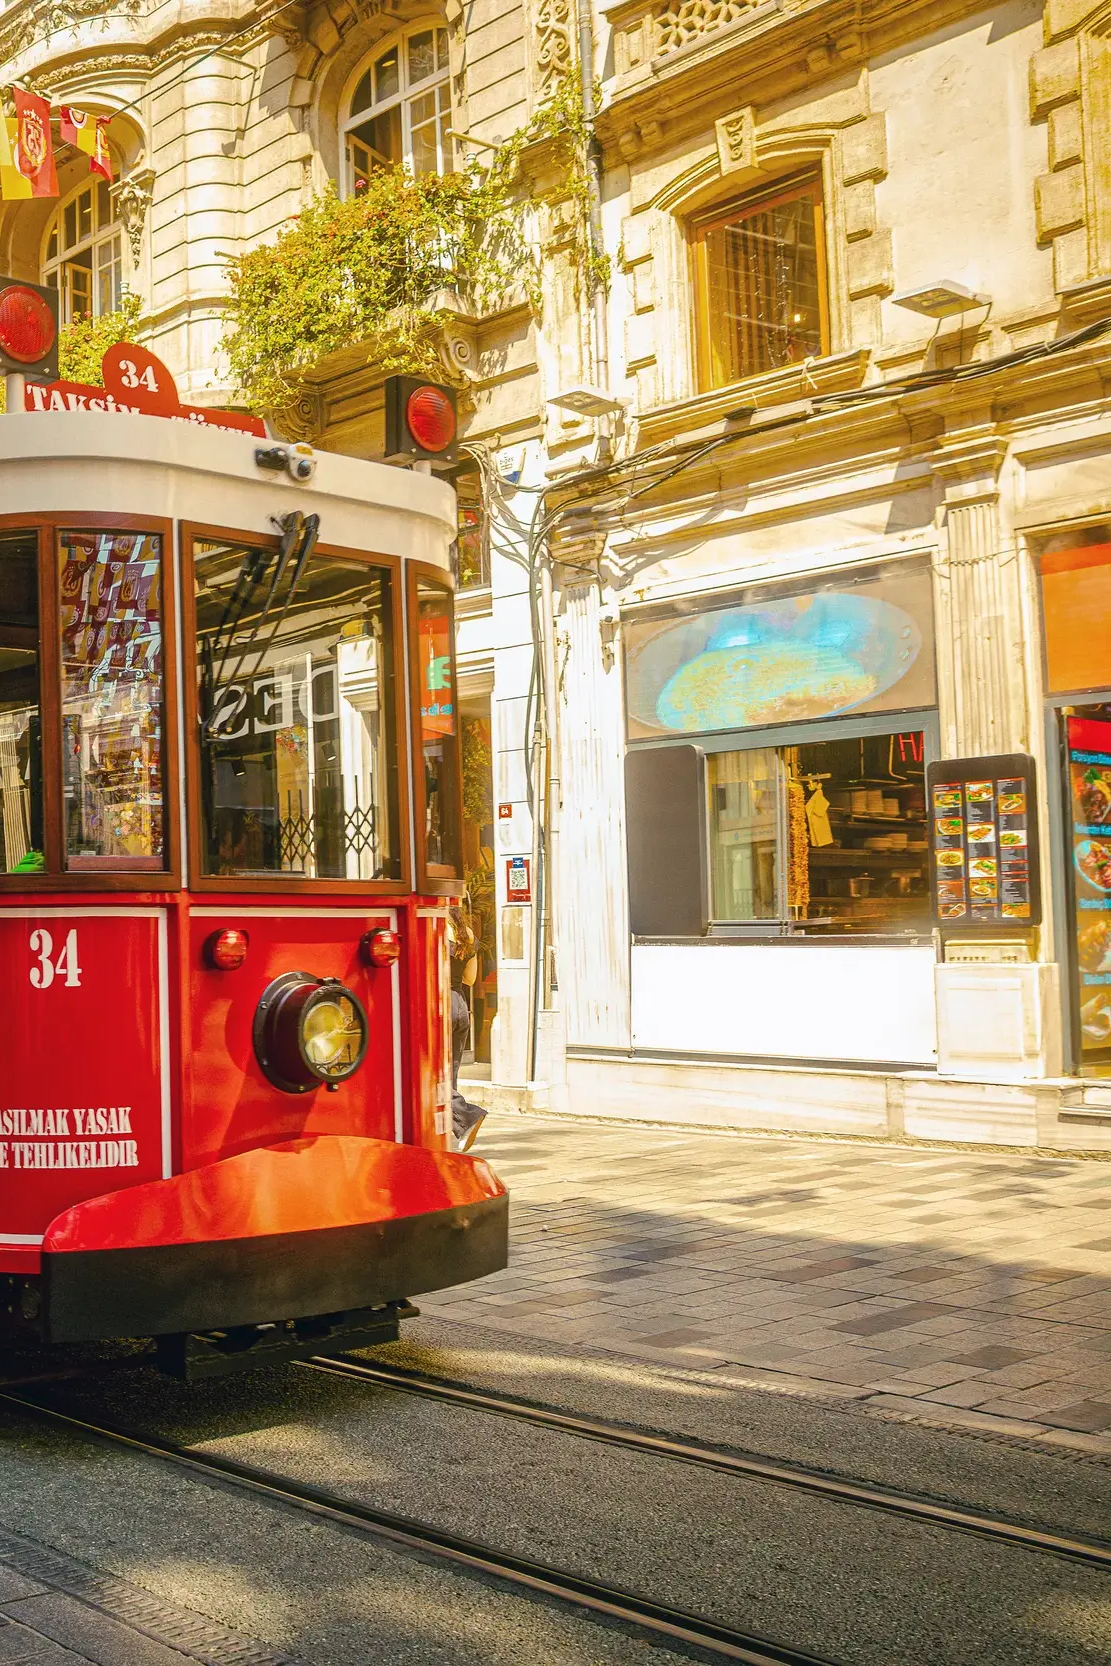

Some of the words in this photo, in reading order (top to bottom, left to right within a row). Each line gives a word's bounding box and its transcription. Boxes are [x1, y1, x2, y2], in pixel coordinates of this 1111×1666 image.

[118, 359, 159, 393] 34
[29, 929, 82, 989] 34
[73, 1107, 132, 1135] YASAK
